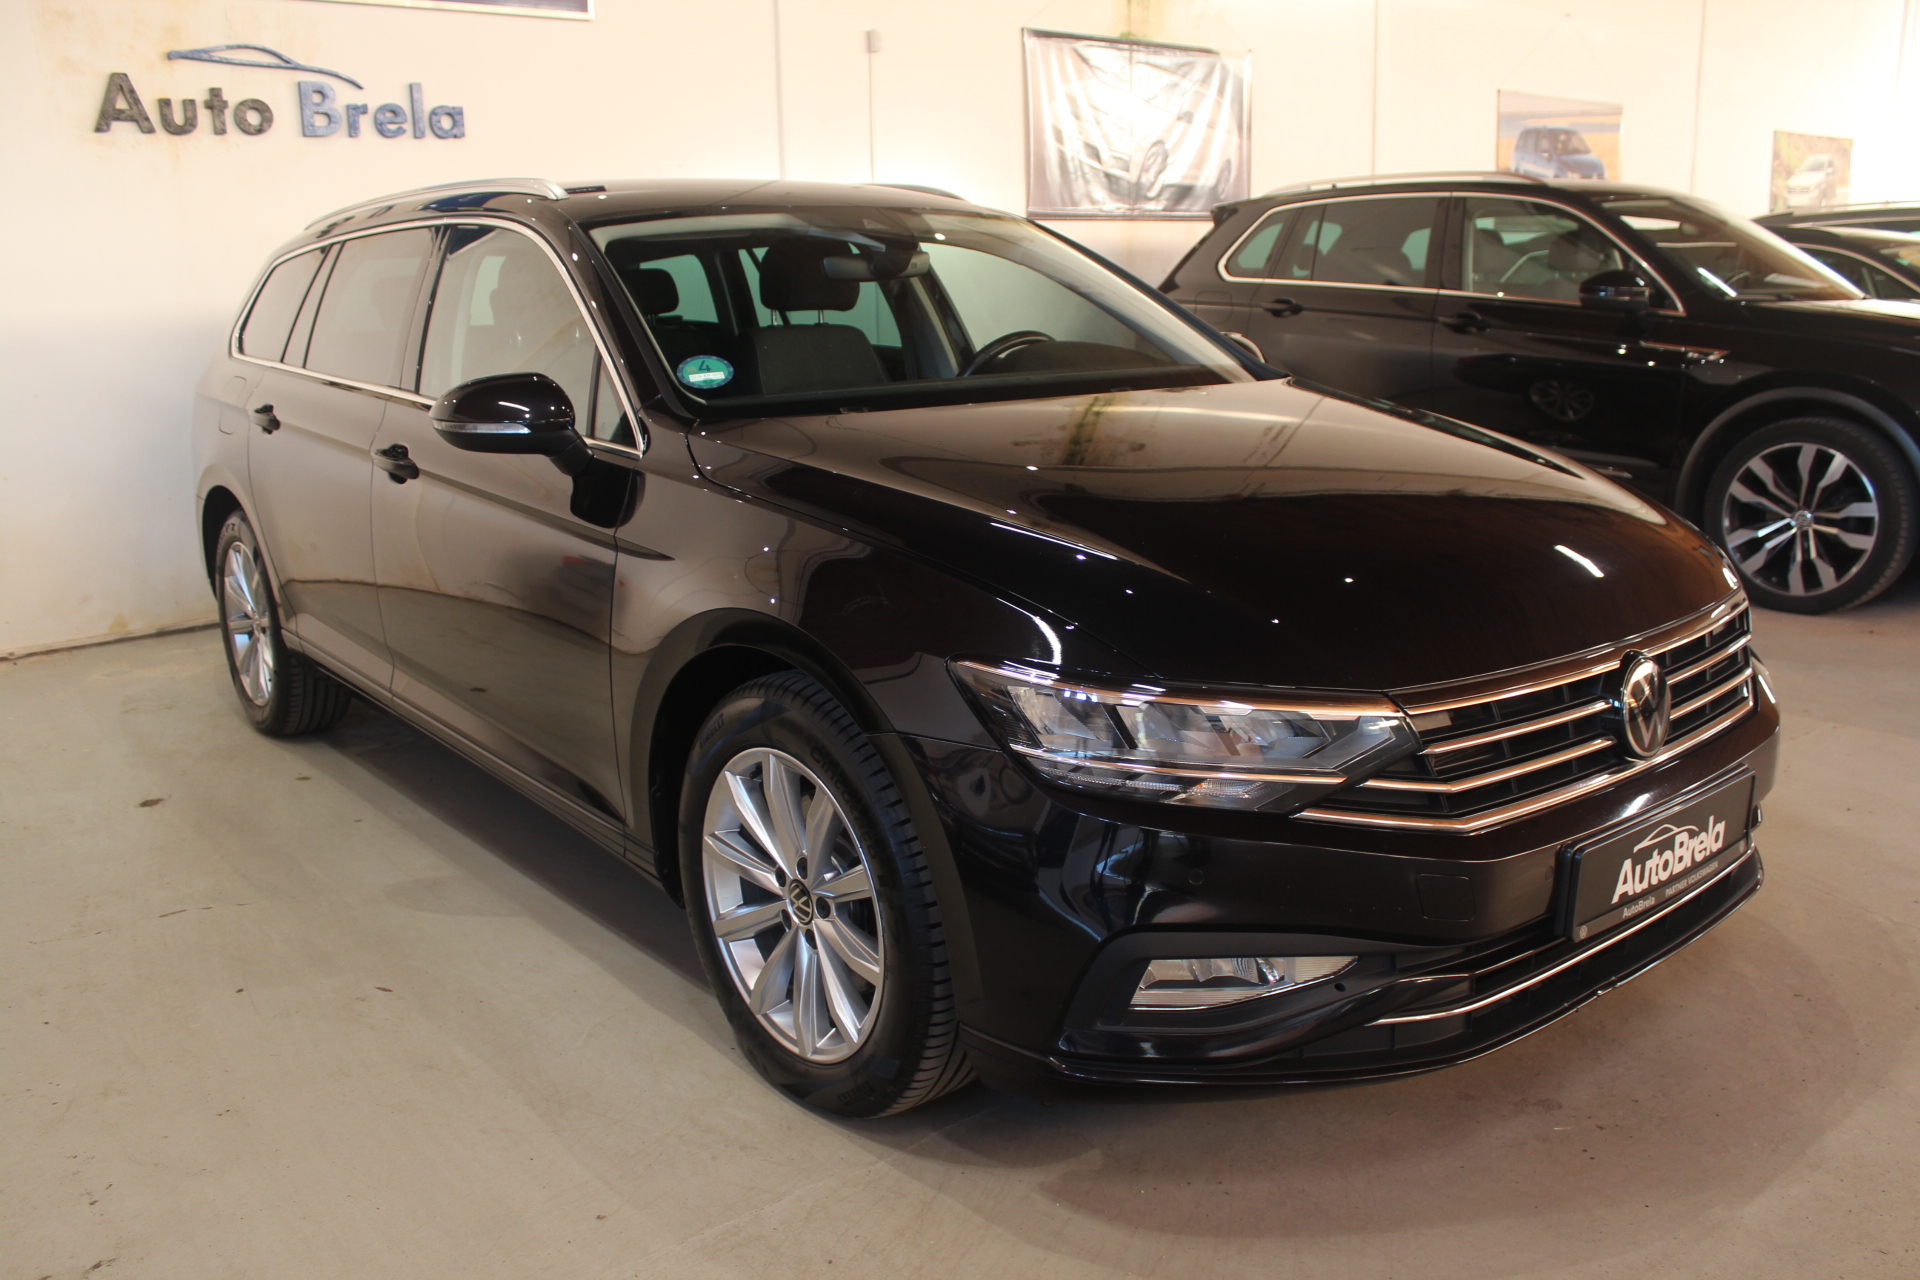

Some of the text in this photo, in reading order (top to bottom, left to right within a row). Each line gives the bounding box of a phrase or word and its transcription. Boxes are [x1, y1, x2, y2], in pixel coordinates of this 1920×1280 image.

[94, 72, 466, 139] Auto Brela
[698, 359, 712, 372] 4
[1611, 815, 1726, 905] AutoBrela
[1622, 895, 1656, 919] AutoBrela
